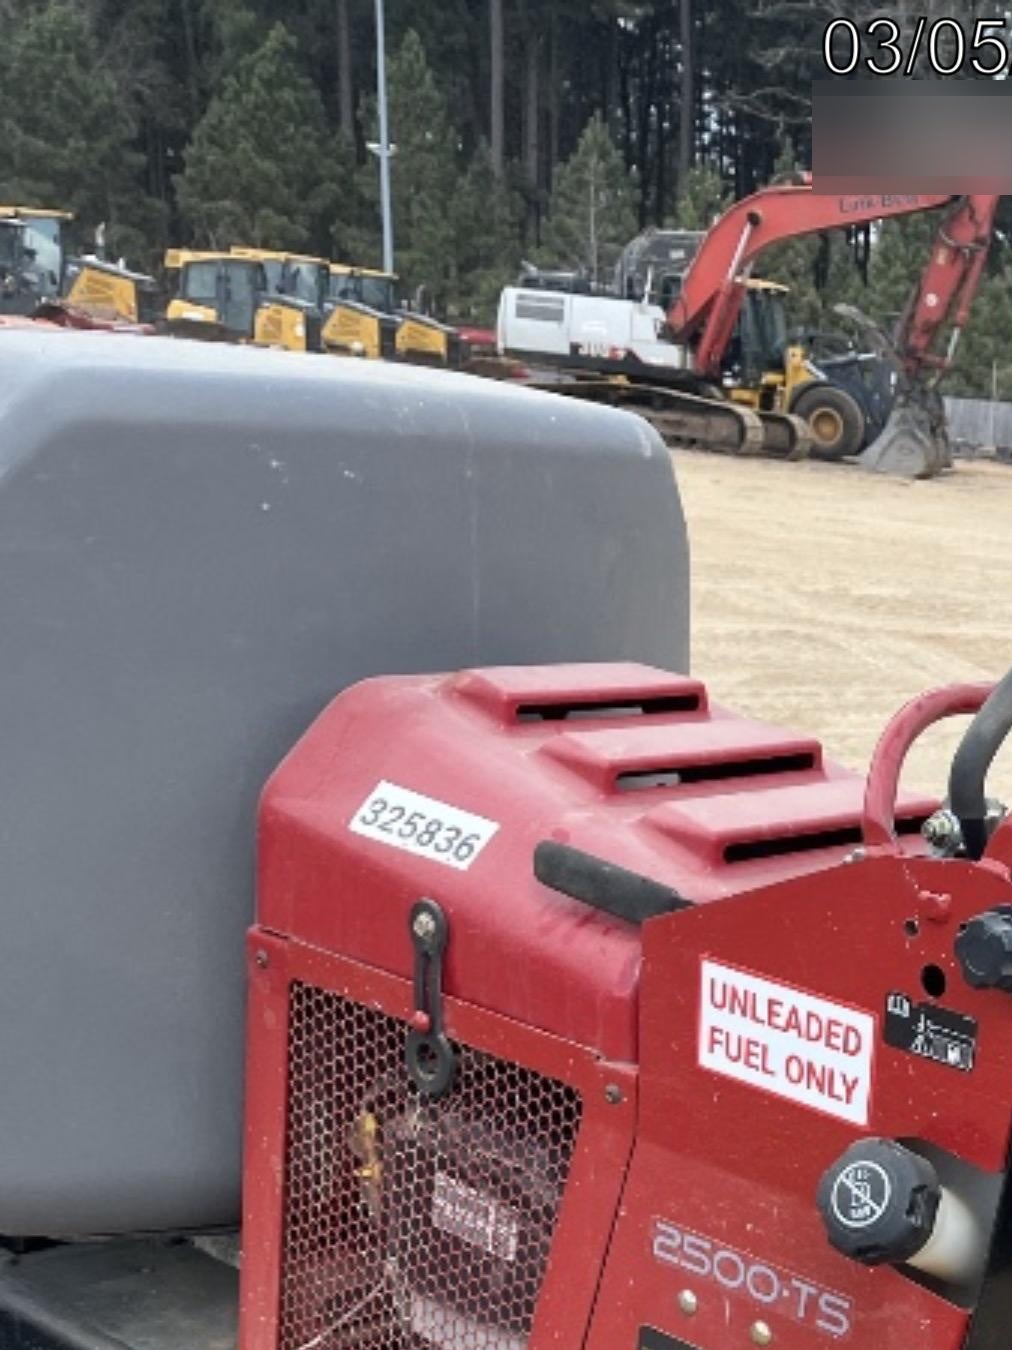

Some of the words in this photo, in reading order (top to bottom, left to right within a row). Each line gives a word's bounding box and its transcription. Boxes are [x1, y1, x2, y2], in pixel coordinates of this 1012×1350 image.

[360, 798, 481, 862] 325836
[709, 977, 863, 1057] UNLEADED
[707, 1025, 775, 1077] FUEL
[784, 1054, 860, 1105] ONLY
